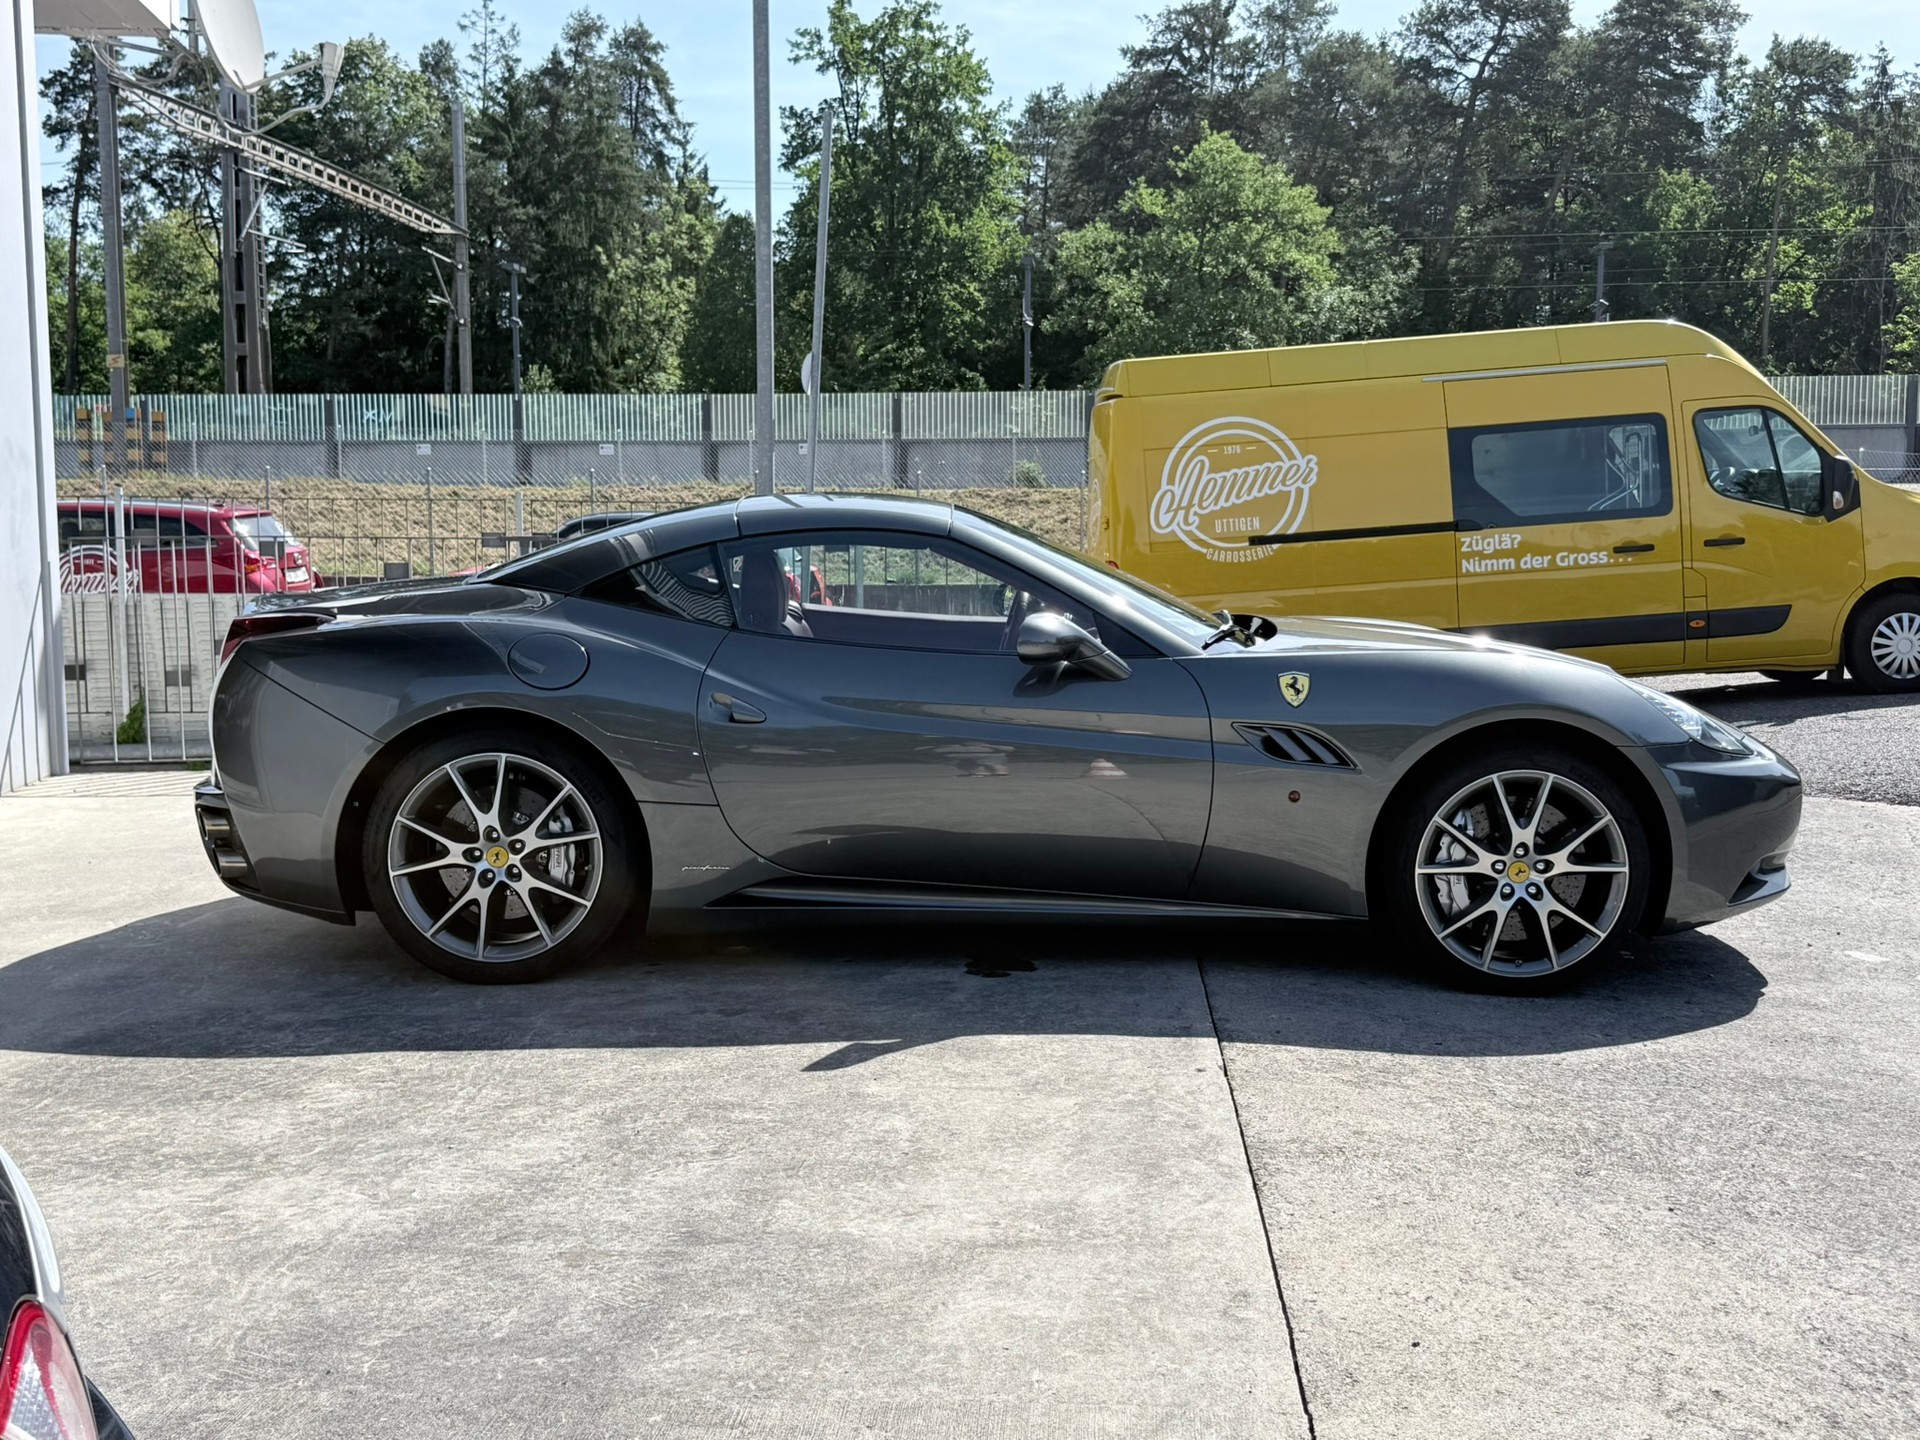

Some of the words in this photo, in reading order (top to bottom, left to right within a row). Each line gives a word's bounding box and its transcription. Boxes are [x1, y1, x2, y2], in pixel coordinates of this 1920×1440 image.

[1215, 516, 1260, 533] UTTIGEN
[1206, 544, 1274, 563] CARROSSERIE
[1460, 533, 1522, 554] Züglä?
[1461, 556, 1515, 574] Nimm
[1520, 553, 1552, 570] der
